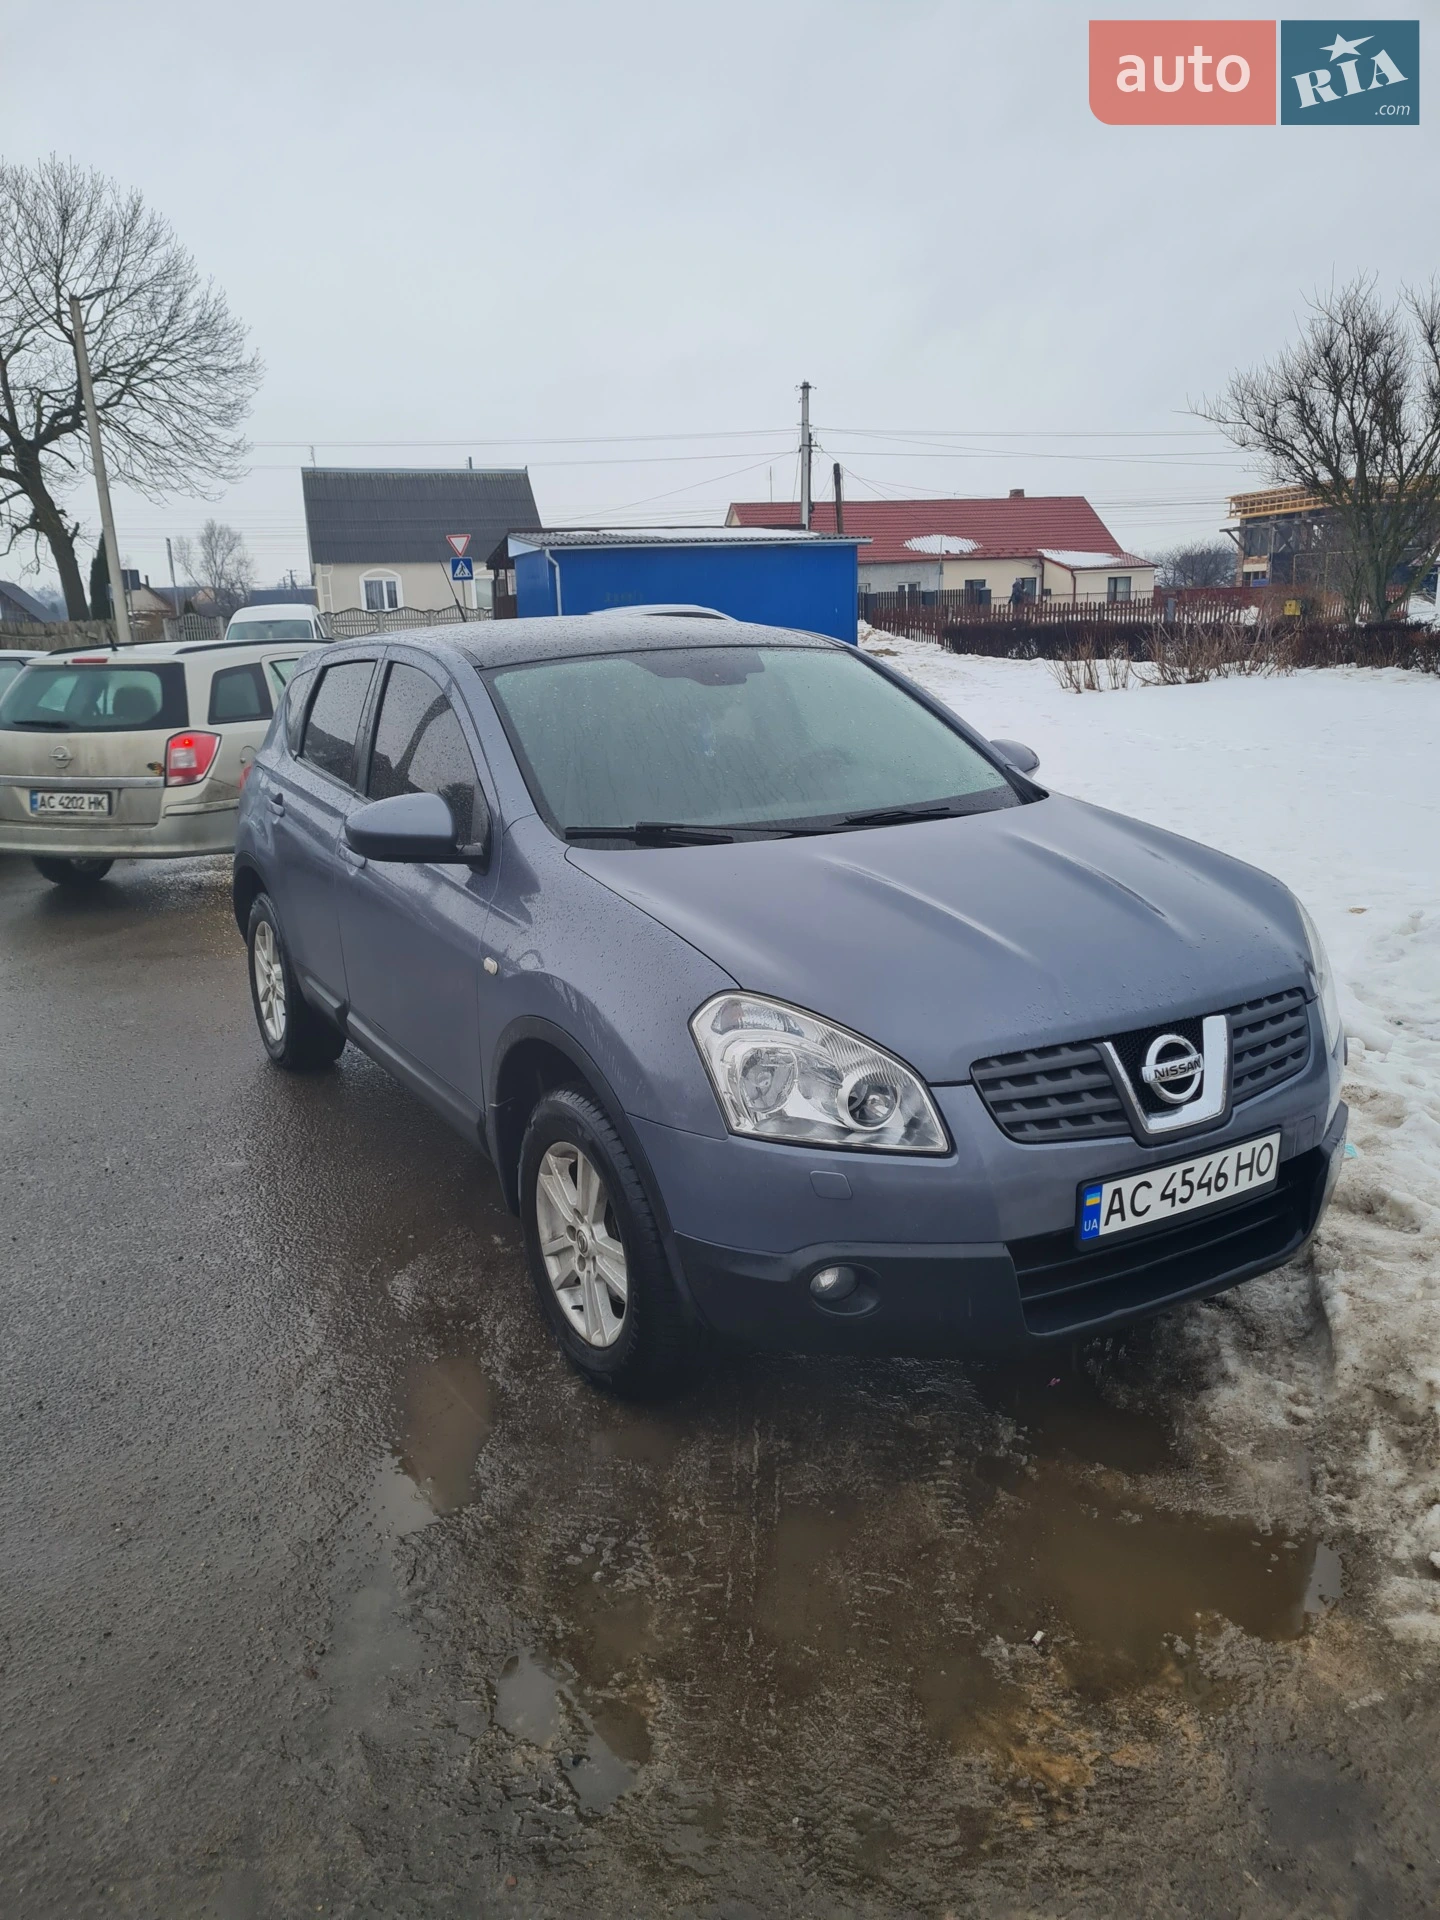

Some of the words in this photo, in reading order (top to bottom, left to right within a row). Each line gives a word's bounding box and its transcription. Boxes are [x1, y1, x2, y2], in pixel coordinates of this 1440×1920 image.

[39, 795, 56, 809] AC
[58, 795, 85, 810] 4202
[88, 796, 106, 810] HK
[1153, 1058, 1202, 1080] NISSAN
[1104, 1180, 1153, 1227] AC
[1160, 1156, 1229, 1208] 4546
[1234, 1142, 1274, 1187] HO
[1084, 1218, 1098, 1232] UA
